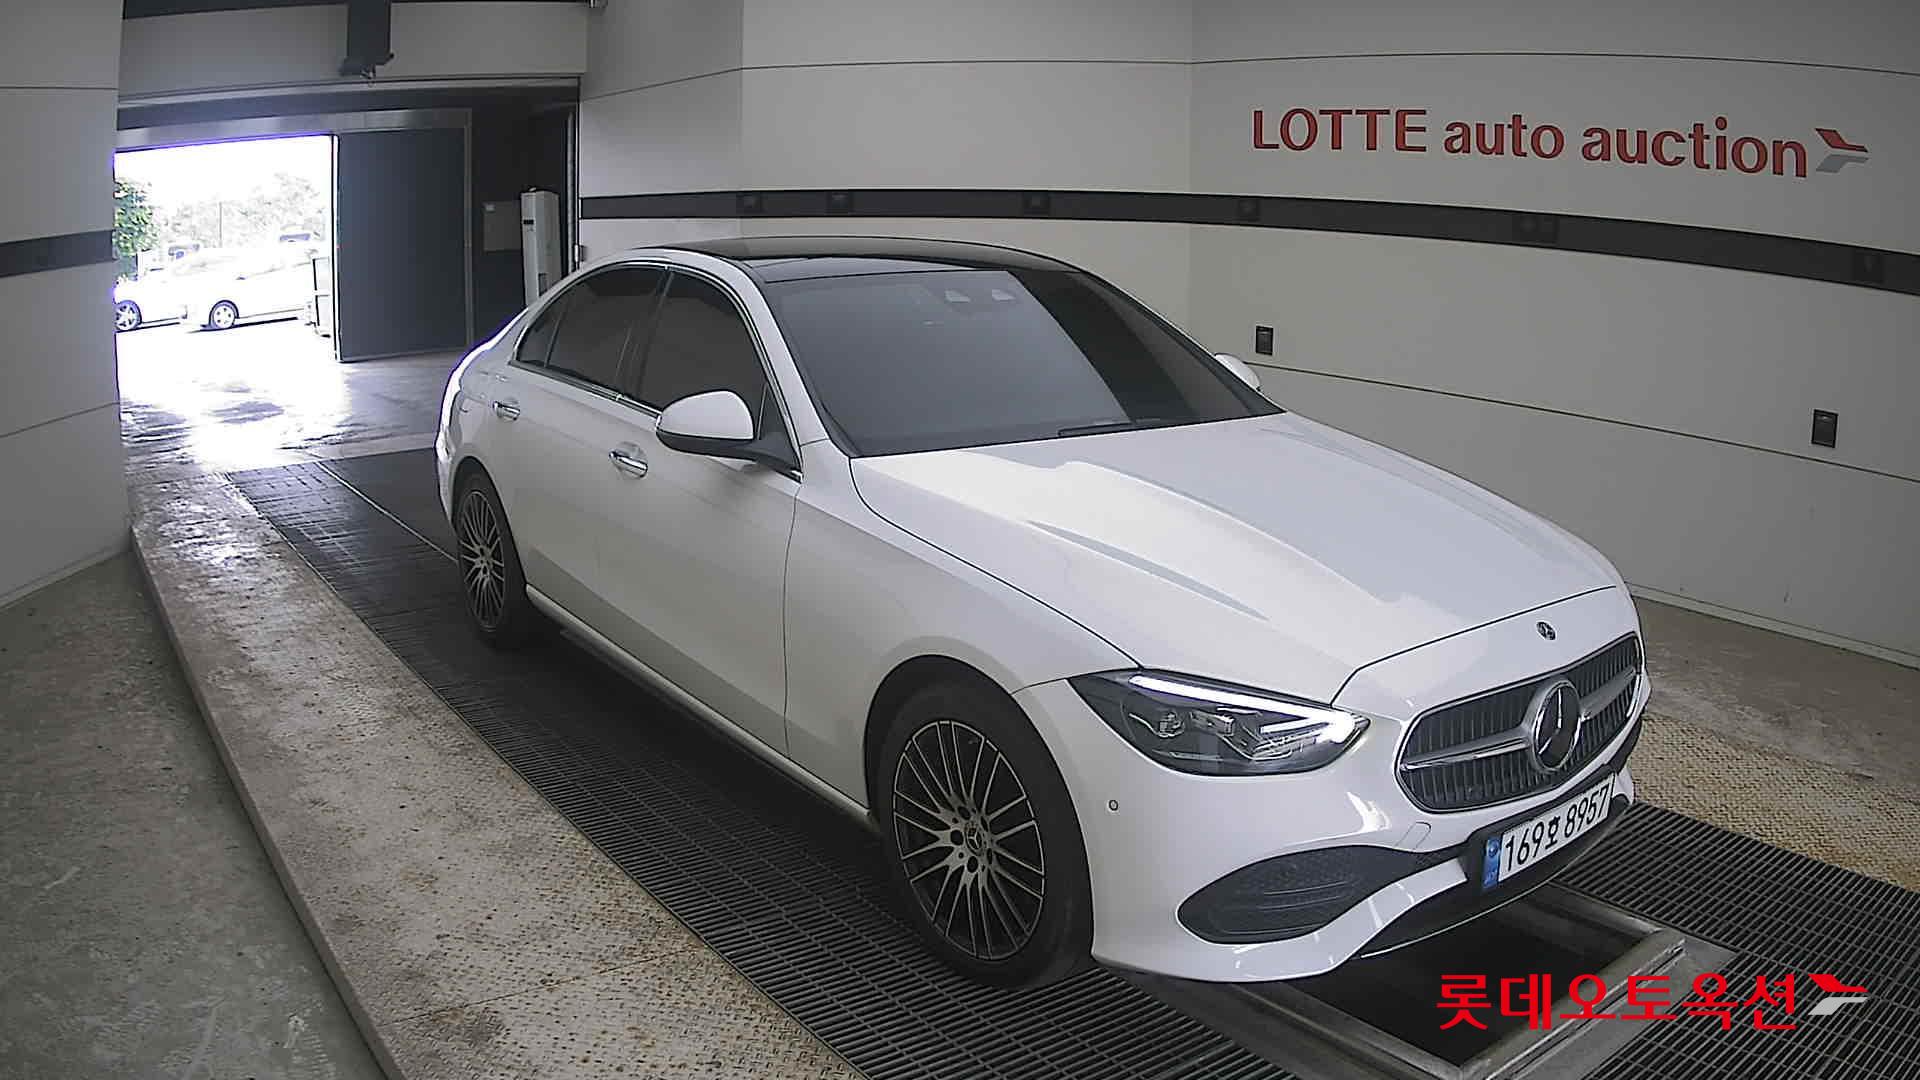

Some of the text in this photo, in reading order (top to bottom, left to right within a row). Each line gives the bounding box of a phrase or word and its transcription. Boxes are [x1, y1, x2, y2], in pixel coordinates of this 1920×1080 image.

[1252, 108, 1808, 178] LOTTE auto auction
[1505, 782, 1610, 872] 169호 8957
